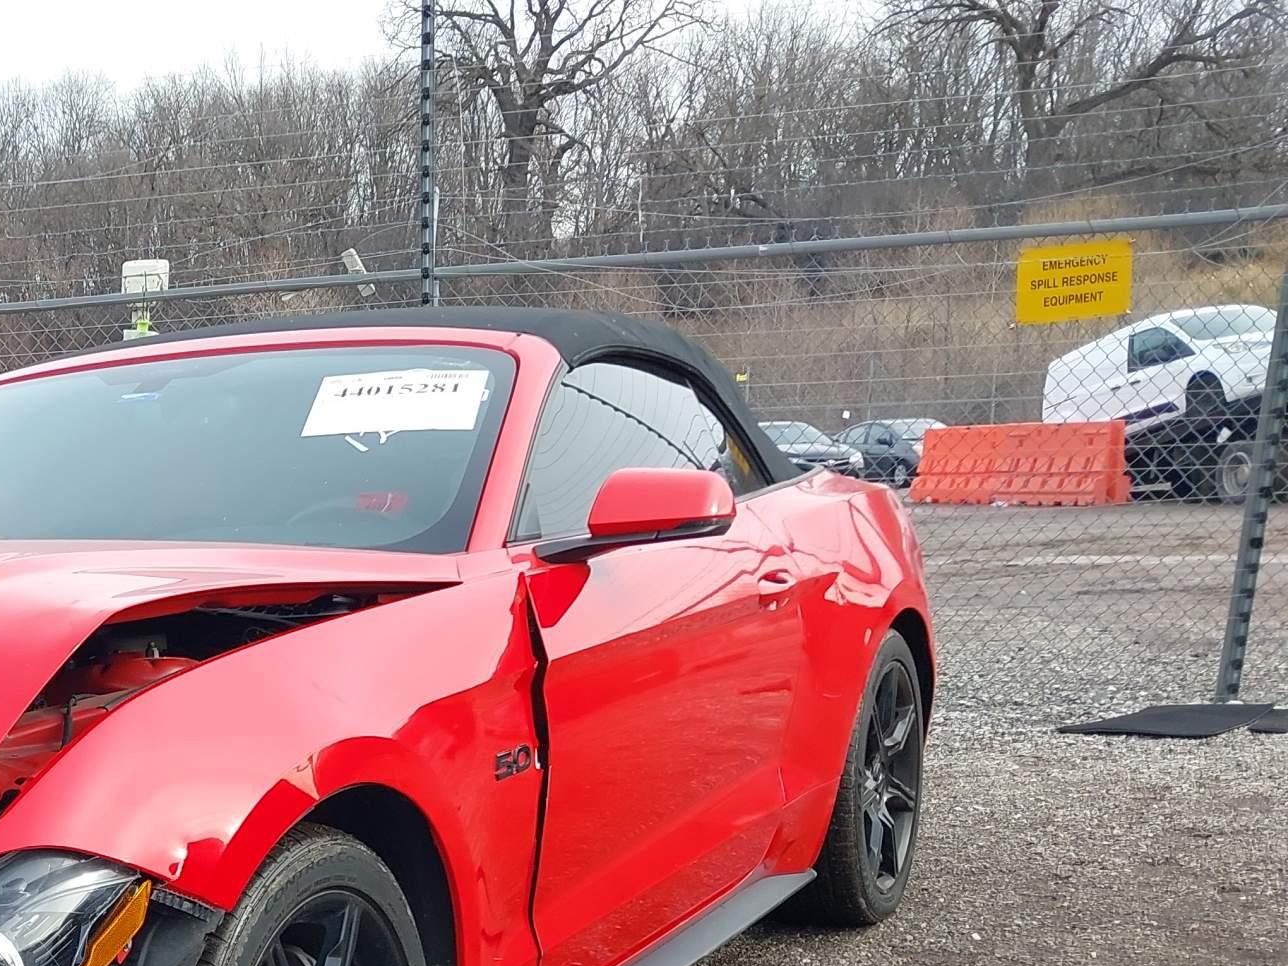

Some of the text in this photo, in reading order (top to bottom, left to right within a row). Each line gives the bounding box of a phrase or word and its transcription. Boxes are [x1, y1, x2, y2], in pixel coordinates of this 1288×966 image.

[1042, 254, 1108, 271] EMERGENCY
[1030, 271, 1118, 290] SPILL RESPONSE
[1043, 291, 1103, 307] EQUIPMENT
[334, 383, 460, 398] 44015281
